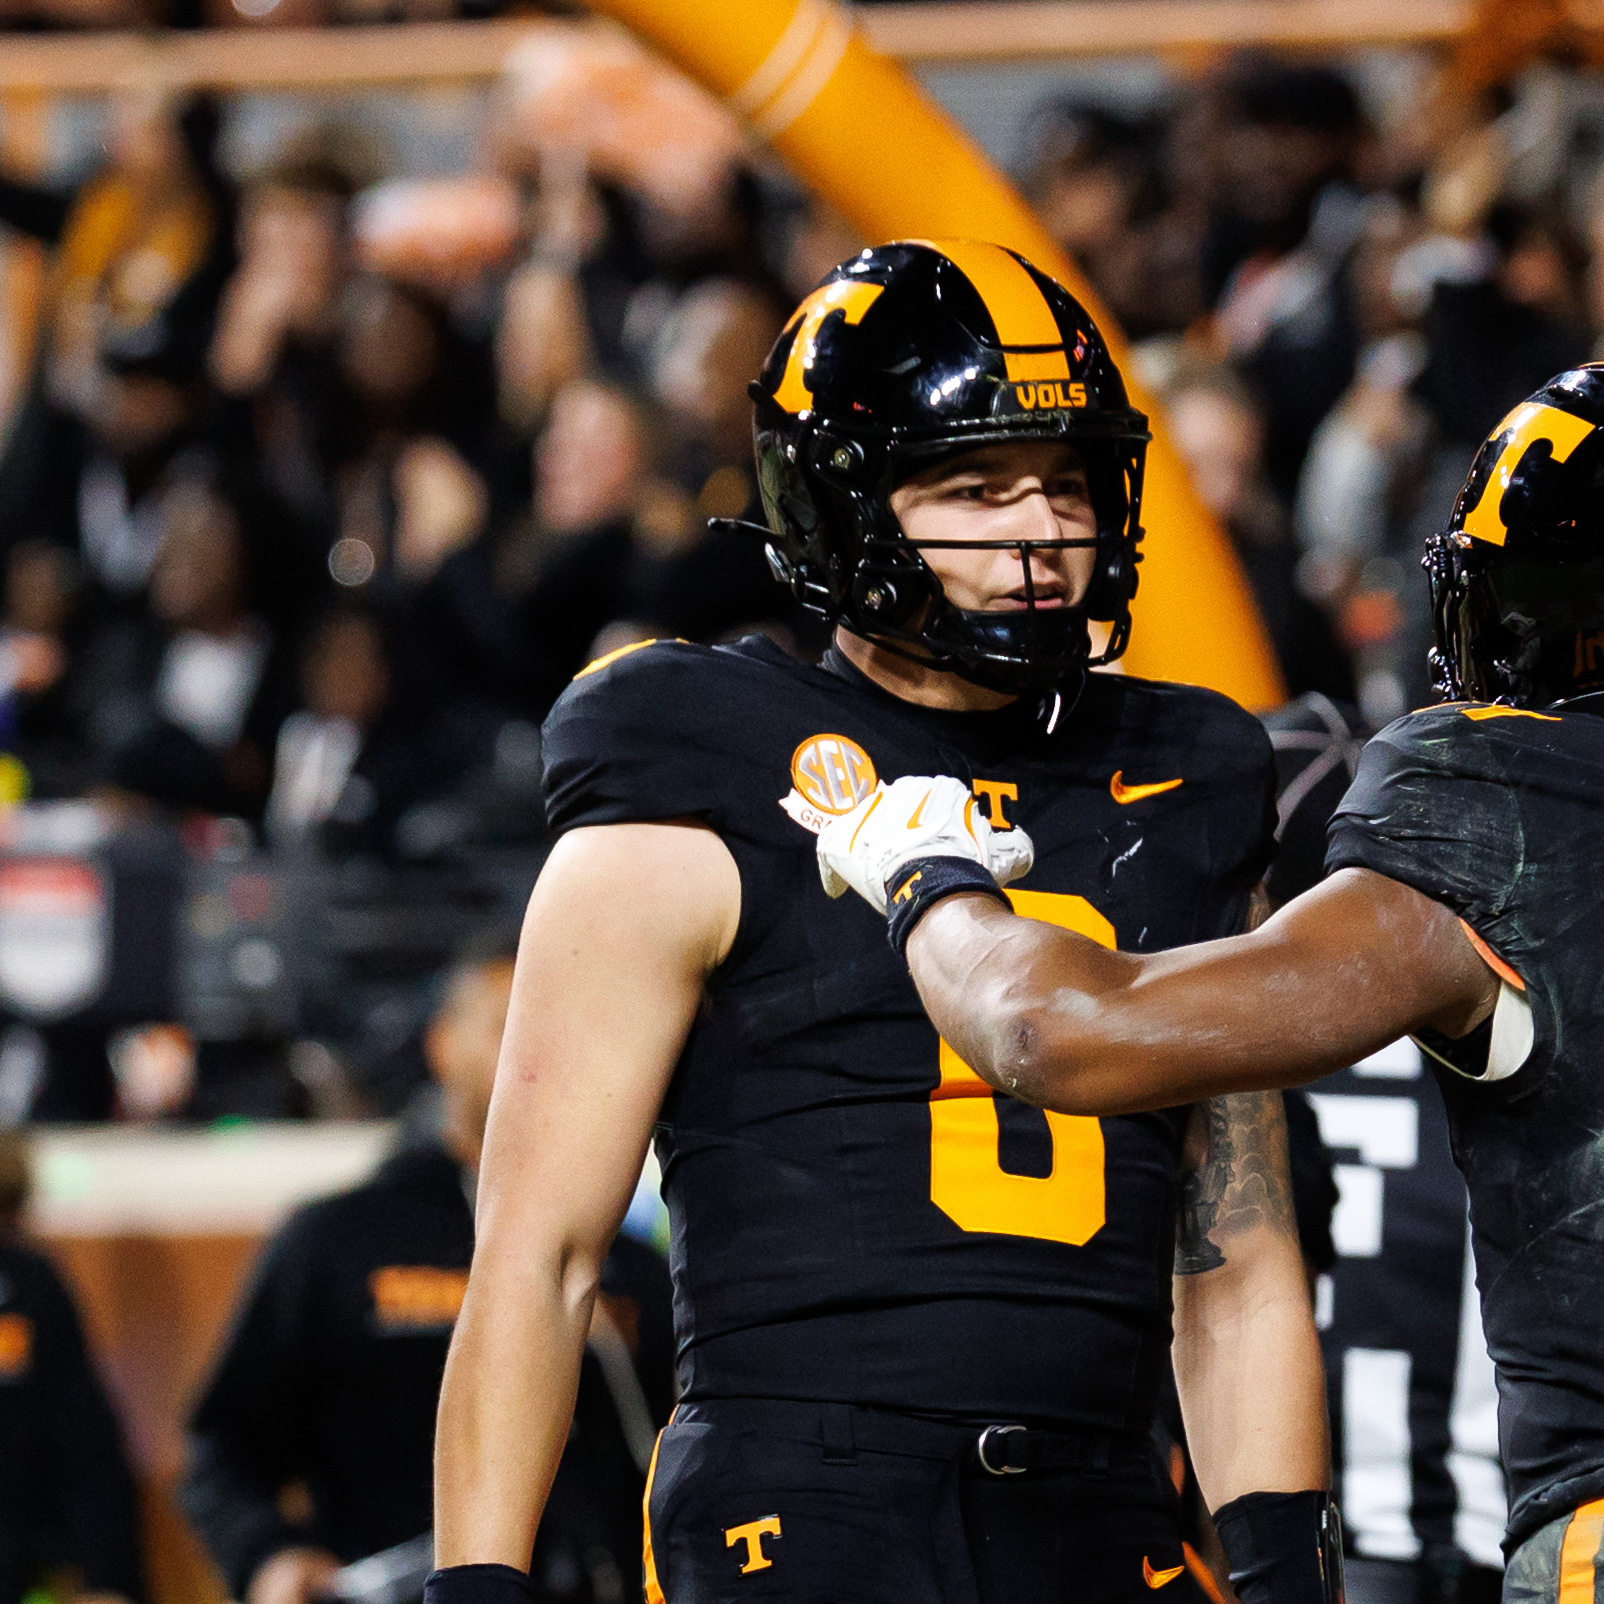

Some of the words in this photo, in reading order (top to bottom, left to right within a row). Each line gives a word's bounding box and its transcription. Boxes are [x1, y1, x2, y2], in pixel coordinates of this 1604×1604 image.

[772, 281, 885, 414] T
[1016, 382, 1088, 411] VOLS
[1463, 403, 1596, 547] T
[798, 739, 871, 811] SEC
[972, 778, 1019, 829] T
[724, 1515, 782, 1575] T
